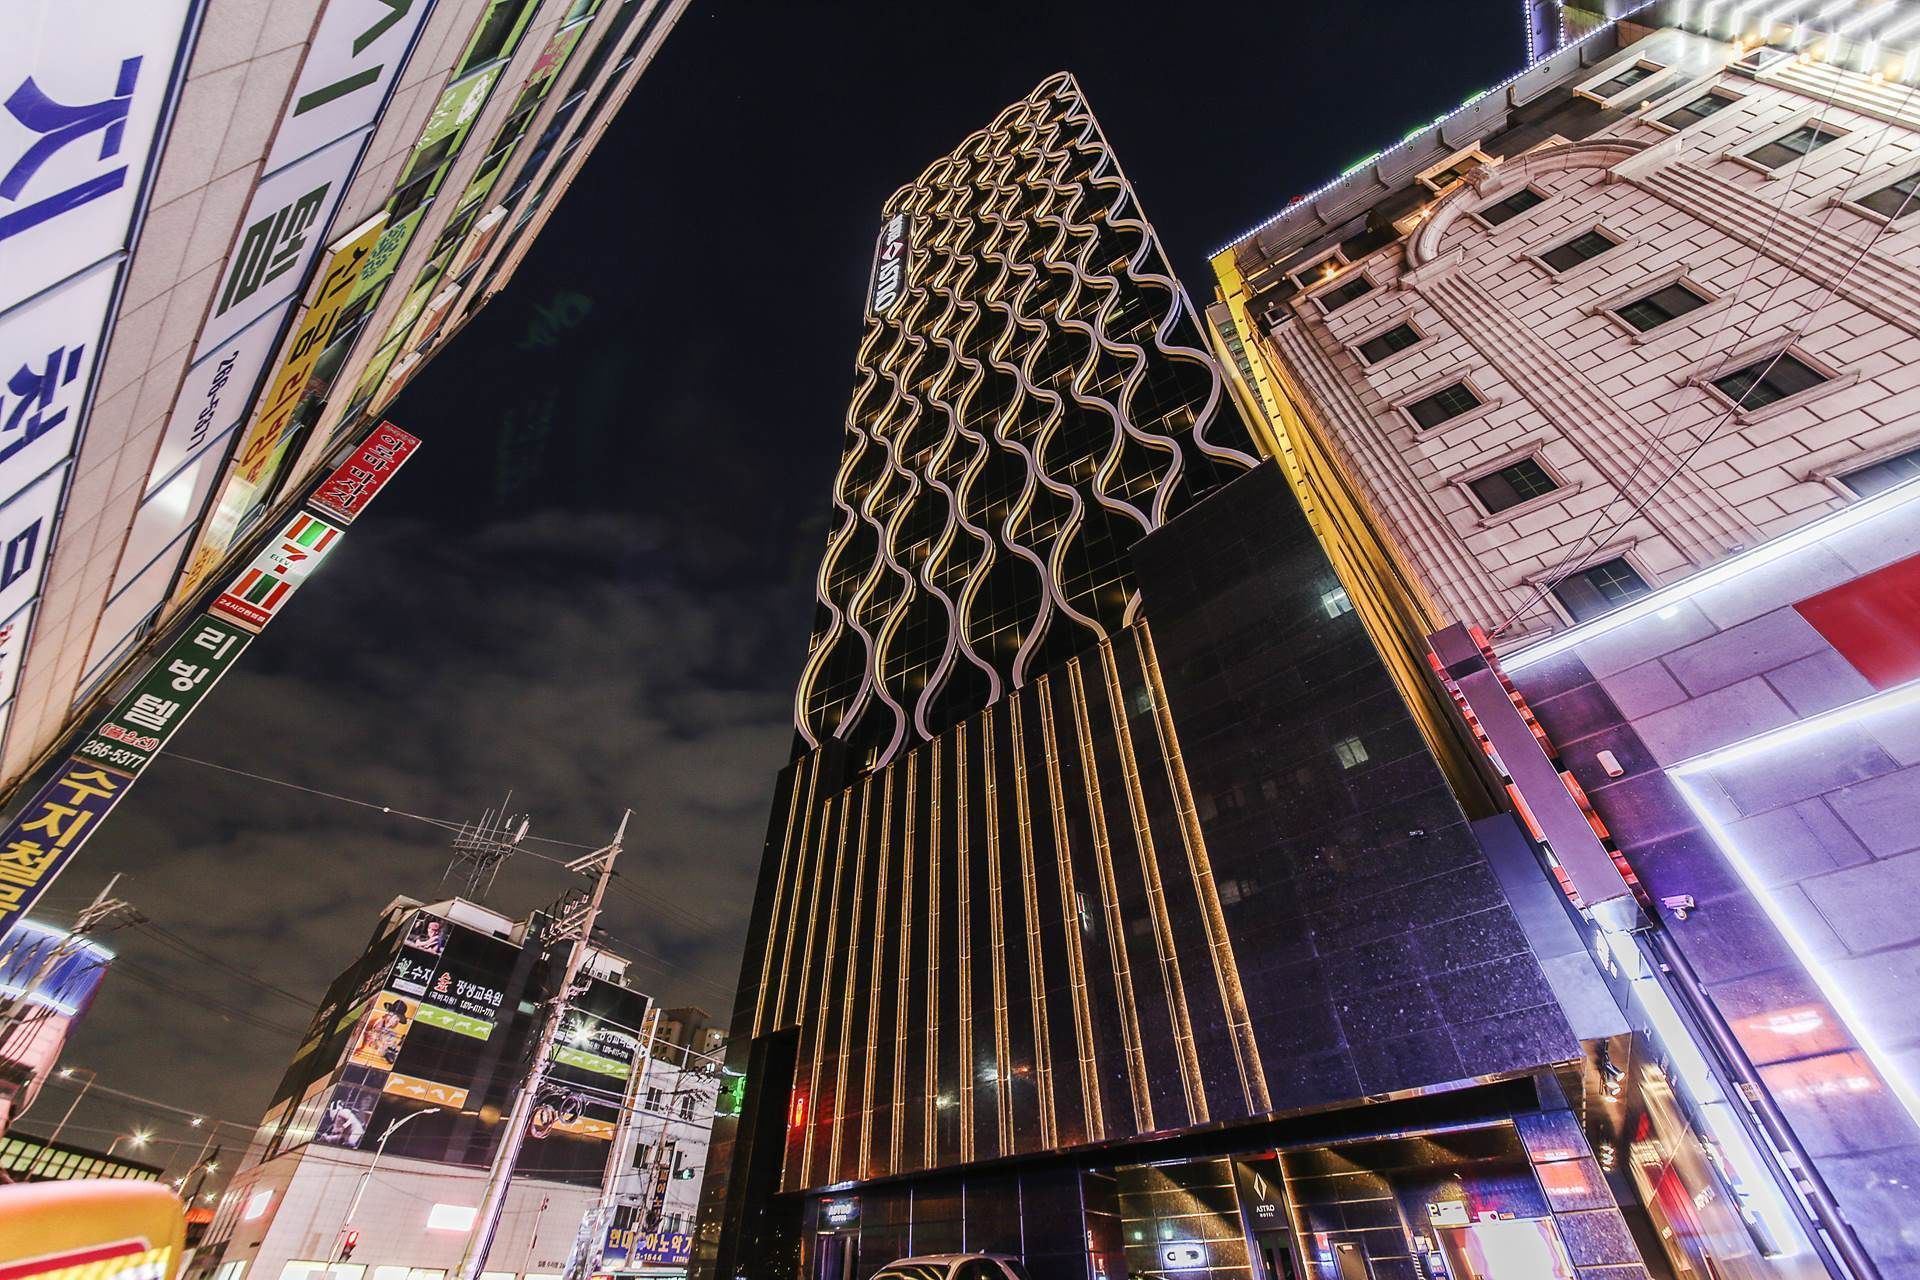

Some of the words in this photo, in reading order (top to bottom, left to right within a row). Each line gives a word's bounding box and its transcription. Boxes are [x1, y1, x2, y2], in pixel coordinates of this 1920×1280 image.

[186, 350, 239, 452] 266-5377
[362, 434, 407, 472] 아로마
[325, 465, 377, 509] 마사지
[123, 626, 238, 732] 리빙텔
[82, 740, 147, 769] 266-5377
[410, 966, 435, 985] 수지
[456, 980, 504, 1007] 평생교육원
[1255, 1204, 1276, 1213] ASTRO
